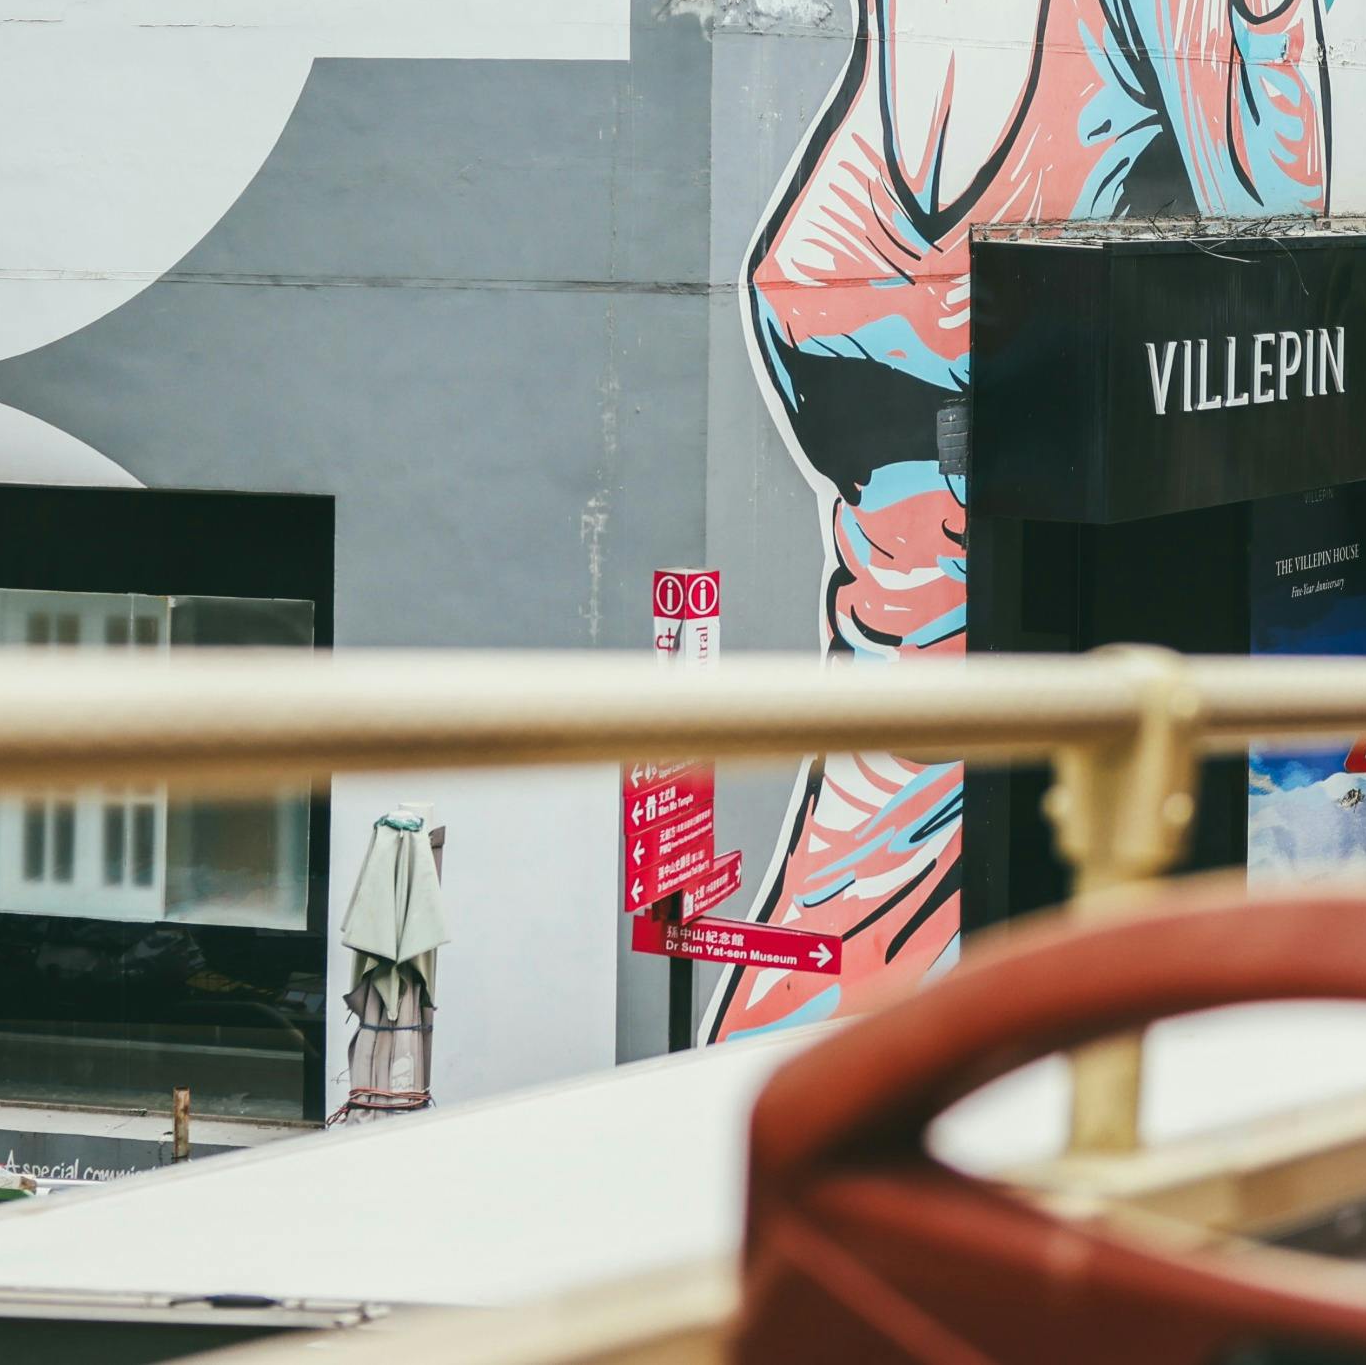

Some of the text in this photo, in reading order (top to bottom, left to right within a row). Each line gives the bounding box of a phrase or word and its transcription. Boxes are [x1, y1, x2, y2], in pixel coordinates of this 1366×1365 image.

[1145, 326, 1345, 415] VILLEPIN
[1275, 543, 1360, 577] THE VILLEPIN HOUSE
[1315, 578, 1345, 592] Anniversary
[666, 925, 745, 947] 孫中山紀念館
[666, 940, 798, 965] Dr Sun Yat-sen Museum
[22, 1158, 79, 1180] special
